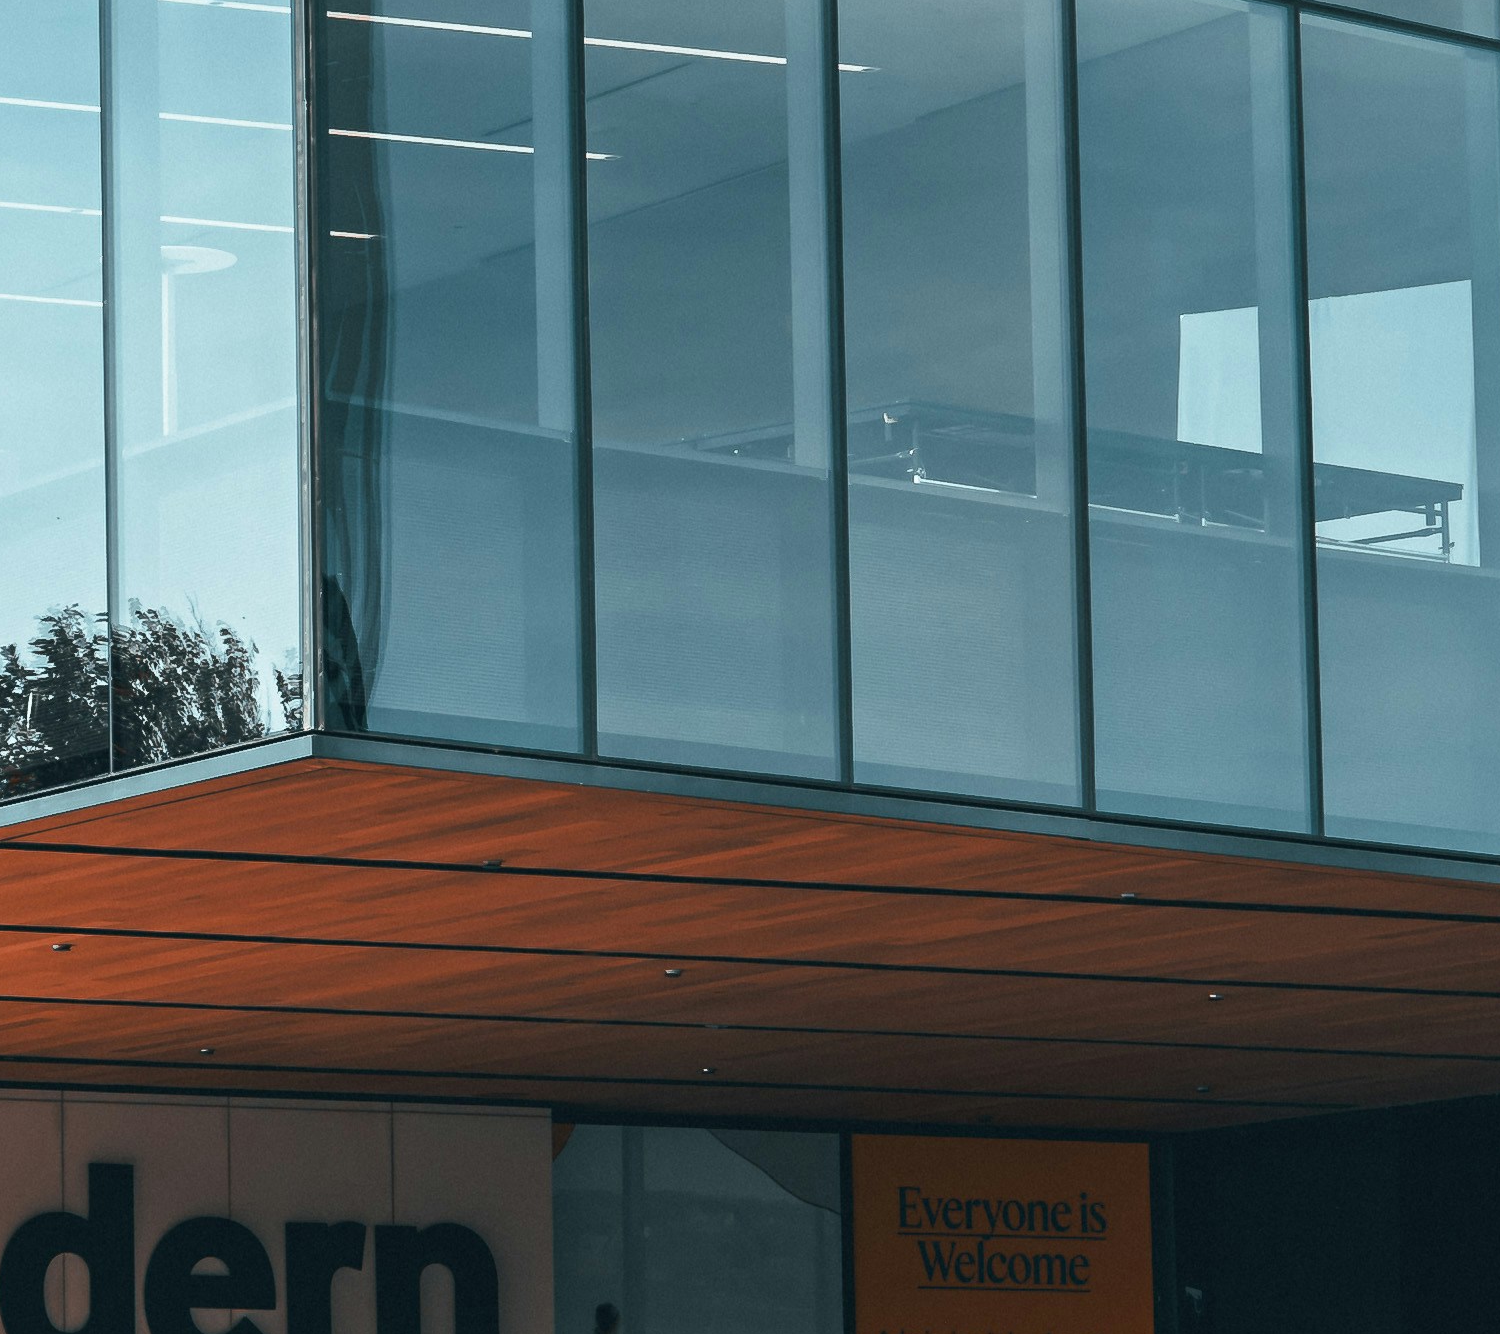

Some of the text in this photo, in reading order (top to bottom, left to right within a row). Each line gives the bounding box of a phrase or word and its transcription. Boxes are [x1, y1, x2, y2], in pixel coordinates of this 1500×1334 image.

[898, 1185, 1107, 1241] Everyone is
[918, 1240, 1089, 1285] Welcome
